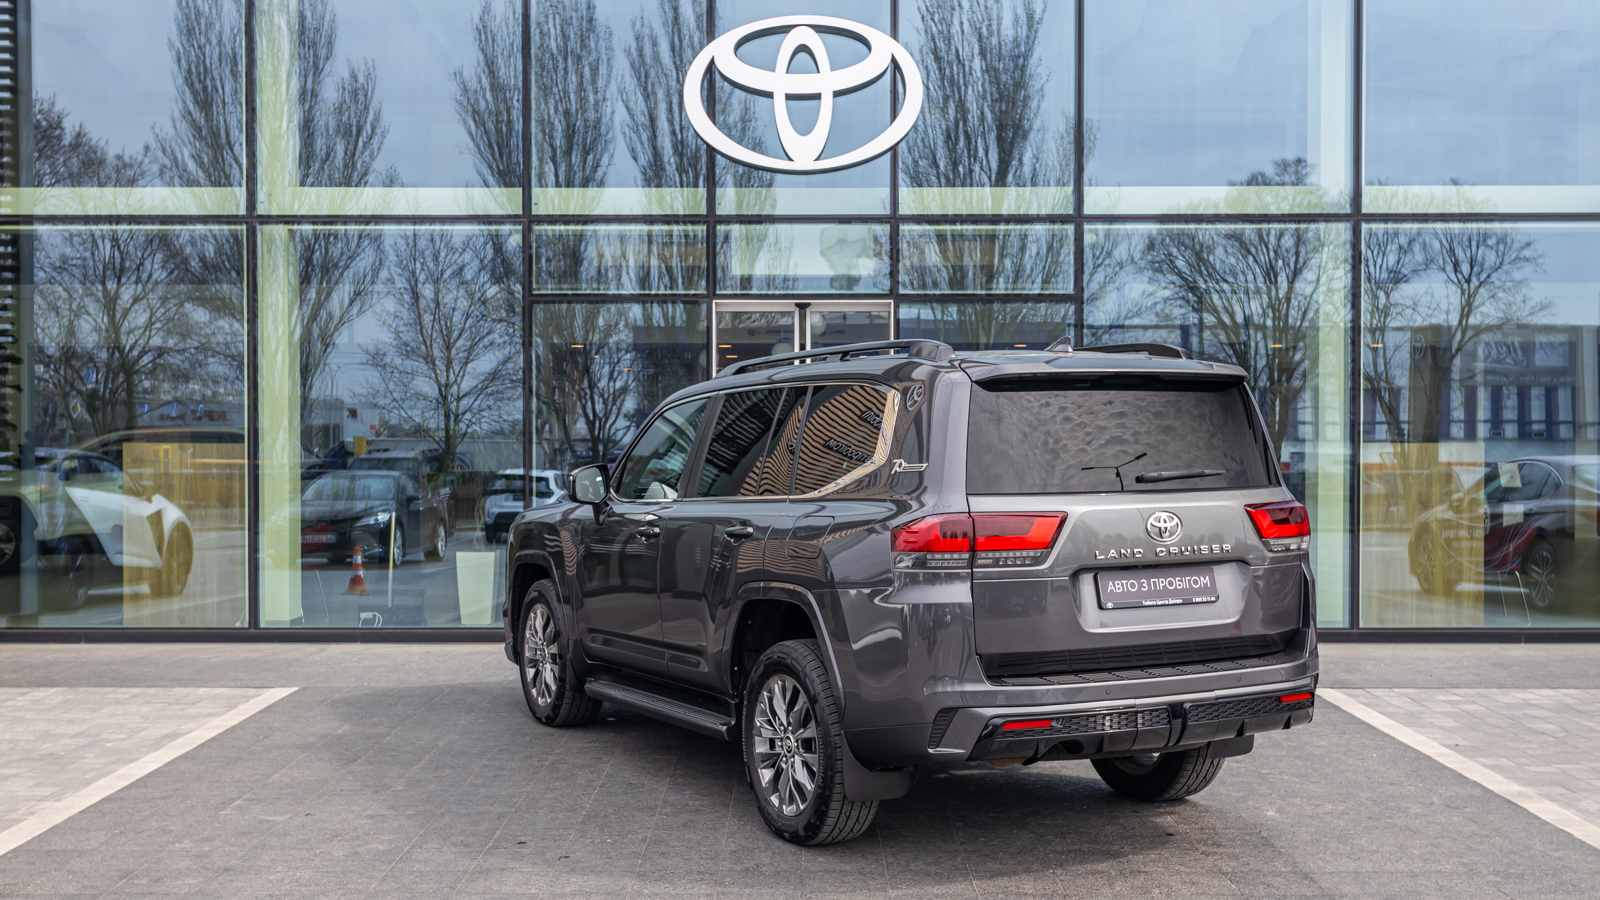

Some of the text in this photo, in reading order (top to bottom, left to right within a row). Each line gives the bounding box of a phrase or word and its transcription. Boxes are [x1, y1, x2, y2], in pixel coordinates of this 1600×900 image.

[1095, 544, 1232, 560] LAND CRUISER
[1107, 575, 1211, 593] АВТО З ПРОБІГОМ
[817, 727, 825, 786] Continental
